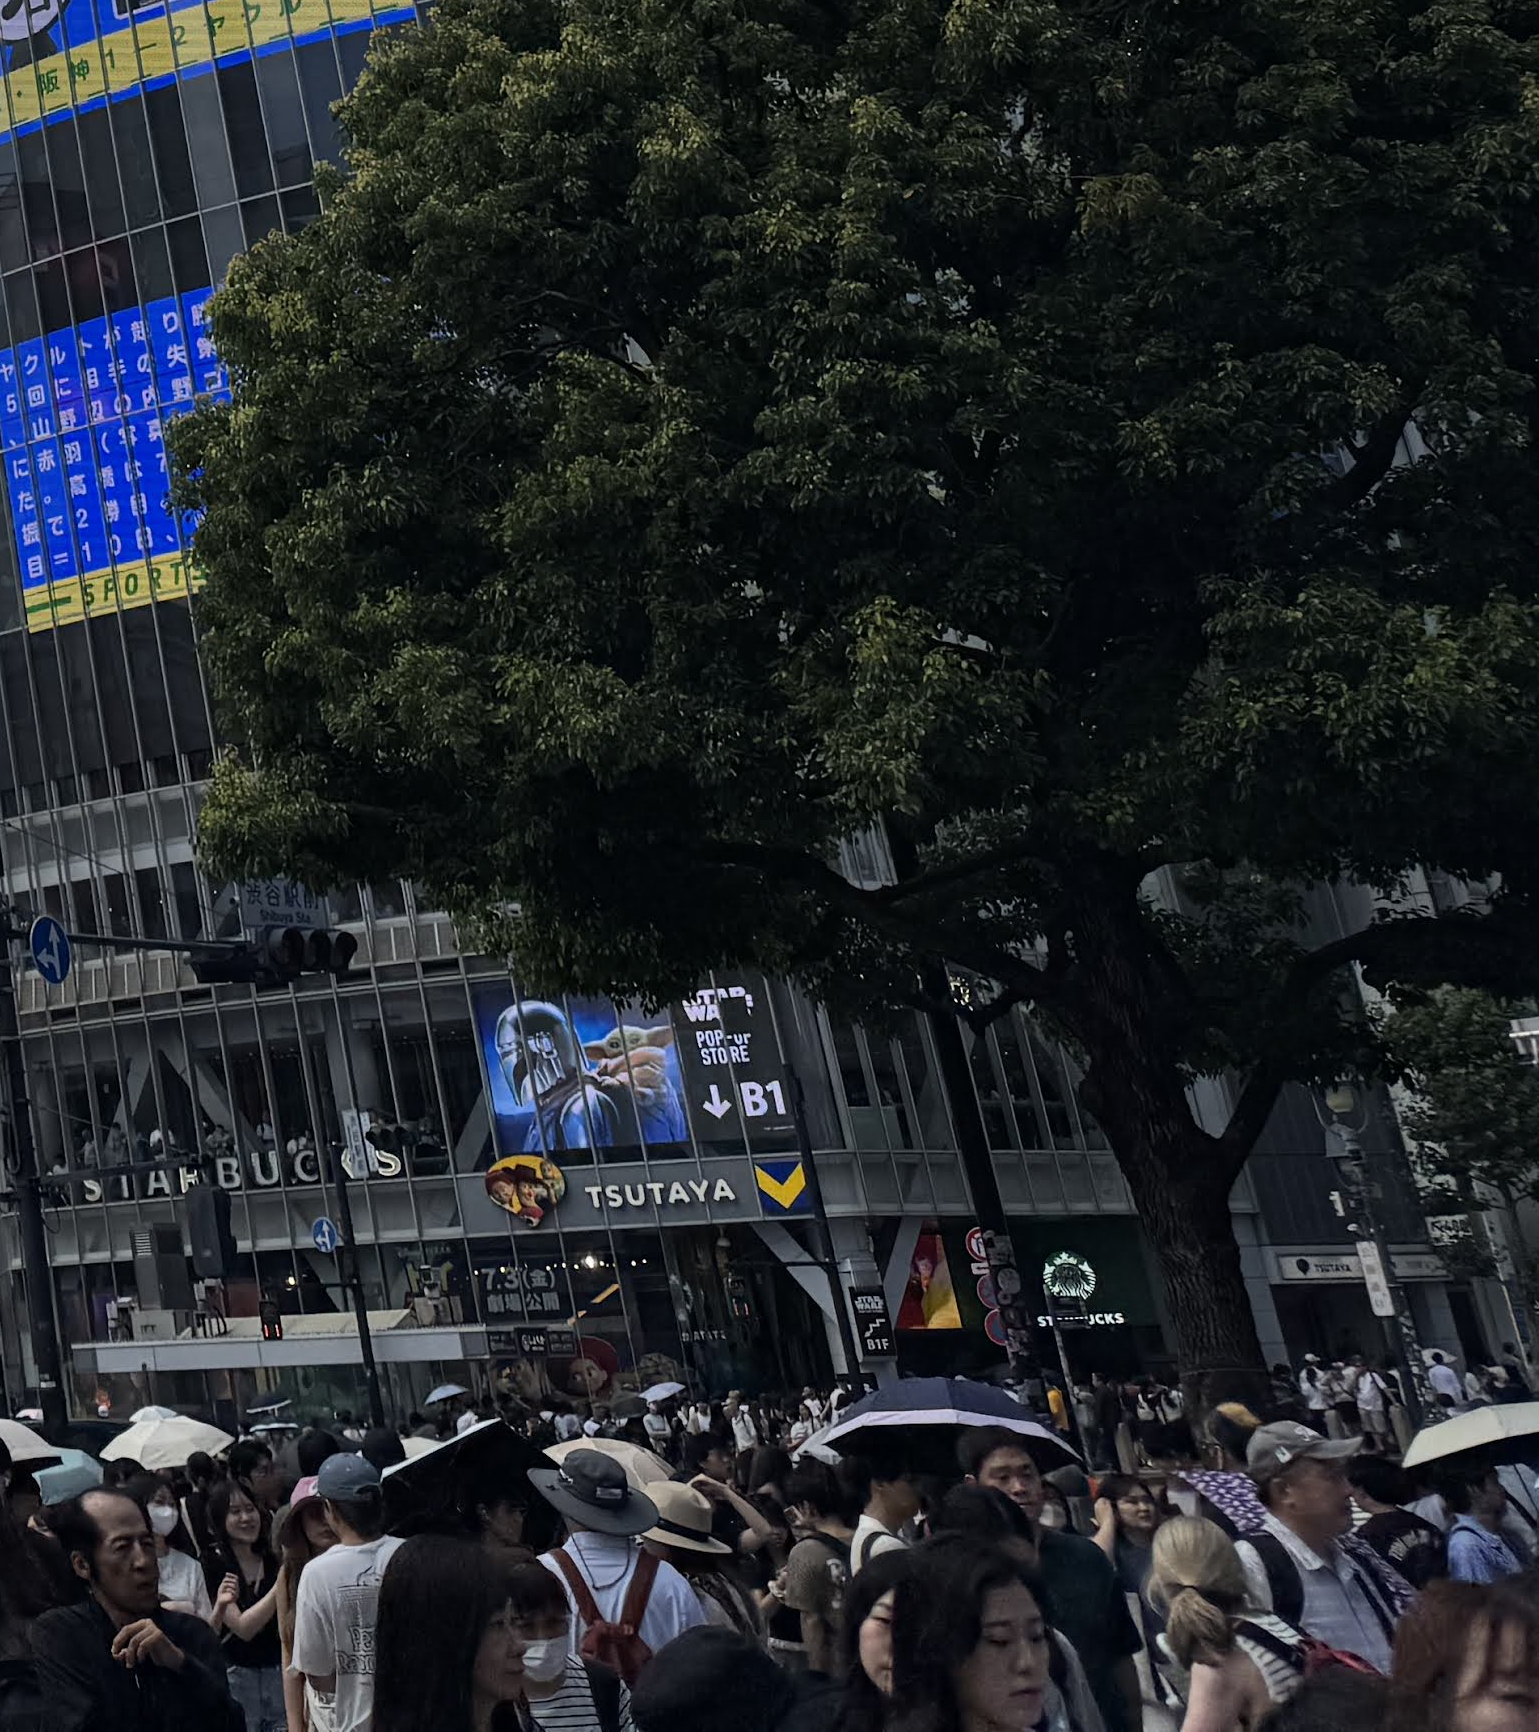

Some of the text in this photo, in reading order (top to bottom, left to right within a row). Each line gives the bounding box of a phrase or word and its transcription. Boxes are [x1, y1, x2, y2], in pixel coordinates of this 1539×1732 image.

[701, 1045, 751, 1066] STORE
[740, 1080, 787, 1117] B1
[81, 1148, 402, 1205] STARBUCS
[585, 1179, 736, 1208] TSUTAYA
